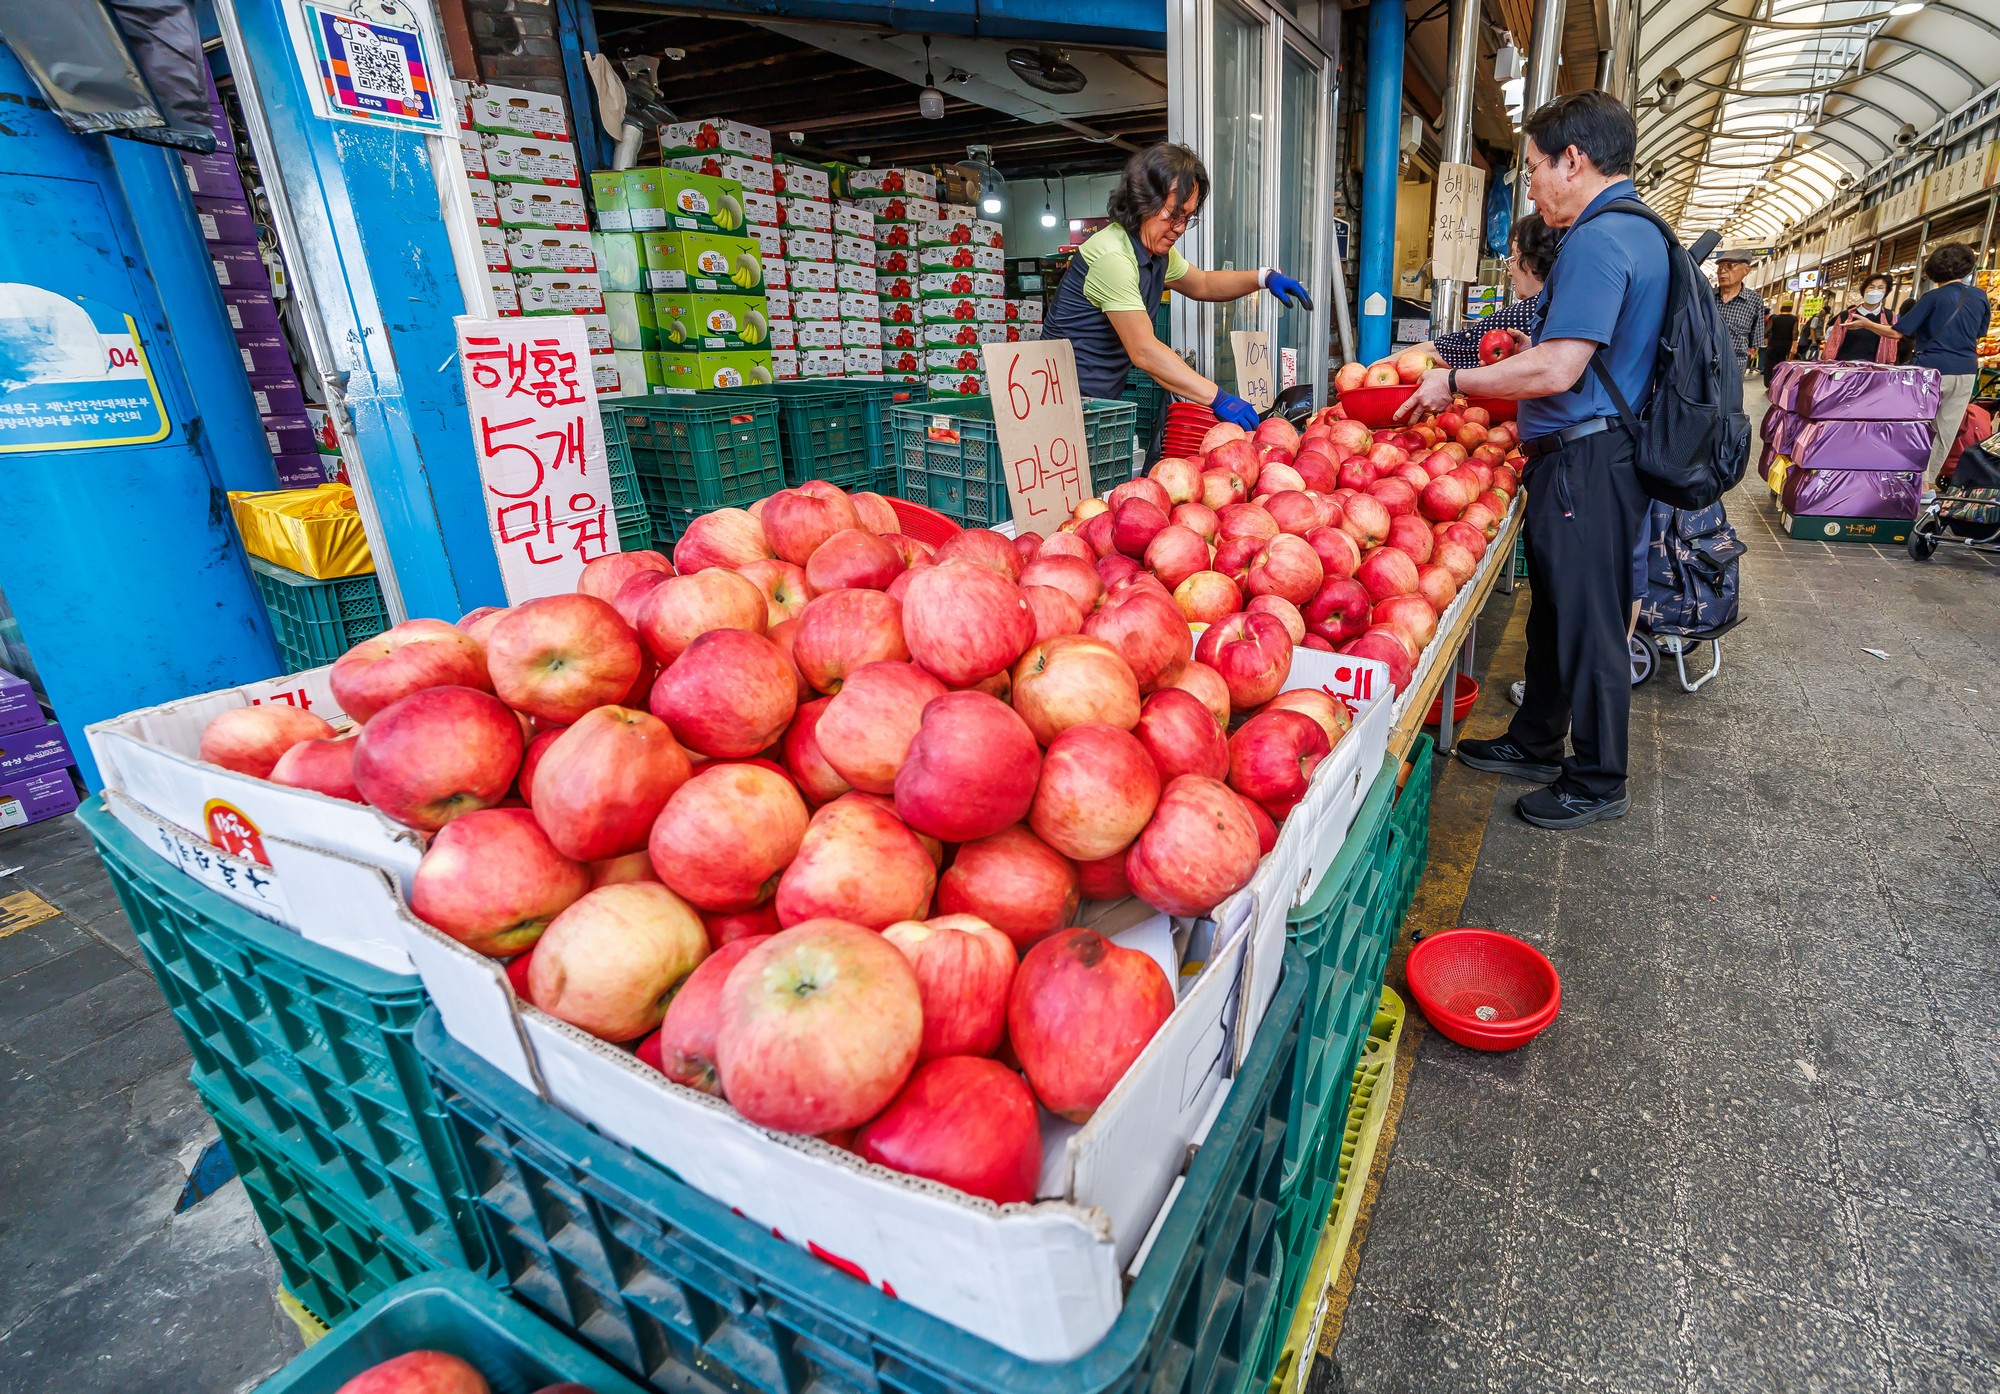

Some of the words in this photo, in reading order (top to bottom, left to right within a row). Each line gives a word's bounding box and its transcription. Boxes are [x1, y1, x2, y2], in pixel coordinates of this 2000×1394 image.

[1440, 215, 1480, 249] 왔습니다
[108, 347, 139, 368] 04
[1246, 341, 1269, 370] 10개
[465, 336, 586, 408] 햇홍로
[1008, 353, 1064, 421] 6개
[46, 397, 149, 413] 재난안전대책본부
[1247, 378, 1270, 409] 만원
[0, 413, 99, 430] 량리청과물시장
[104, 410, 142, 424] 상인회
[480, 416, 586, 498] 5개
[1013, 437, 1082, 517] 만원
[497, 492, 608, 565] 만원
[1845, 524, 1877, 534] 나주배
